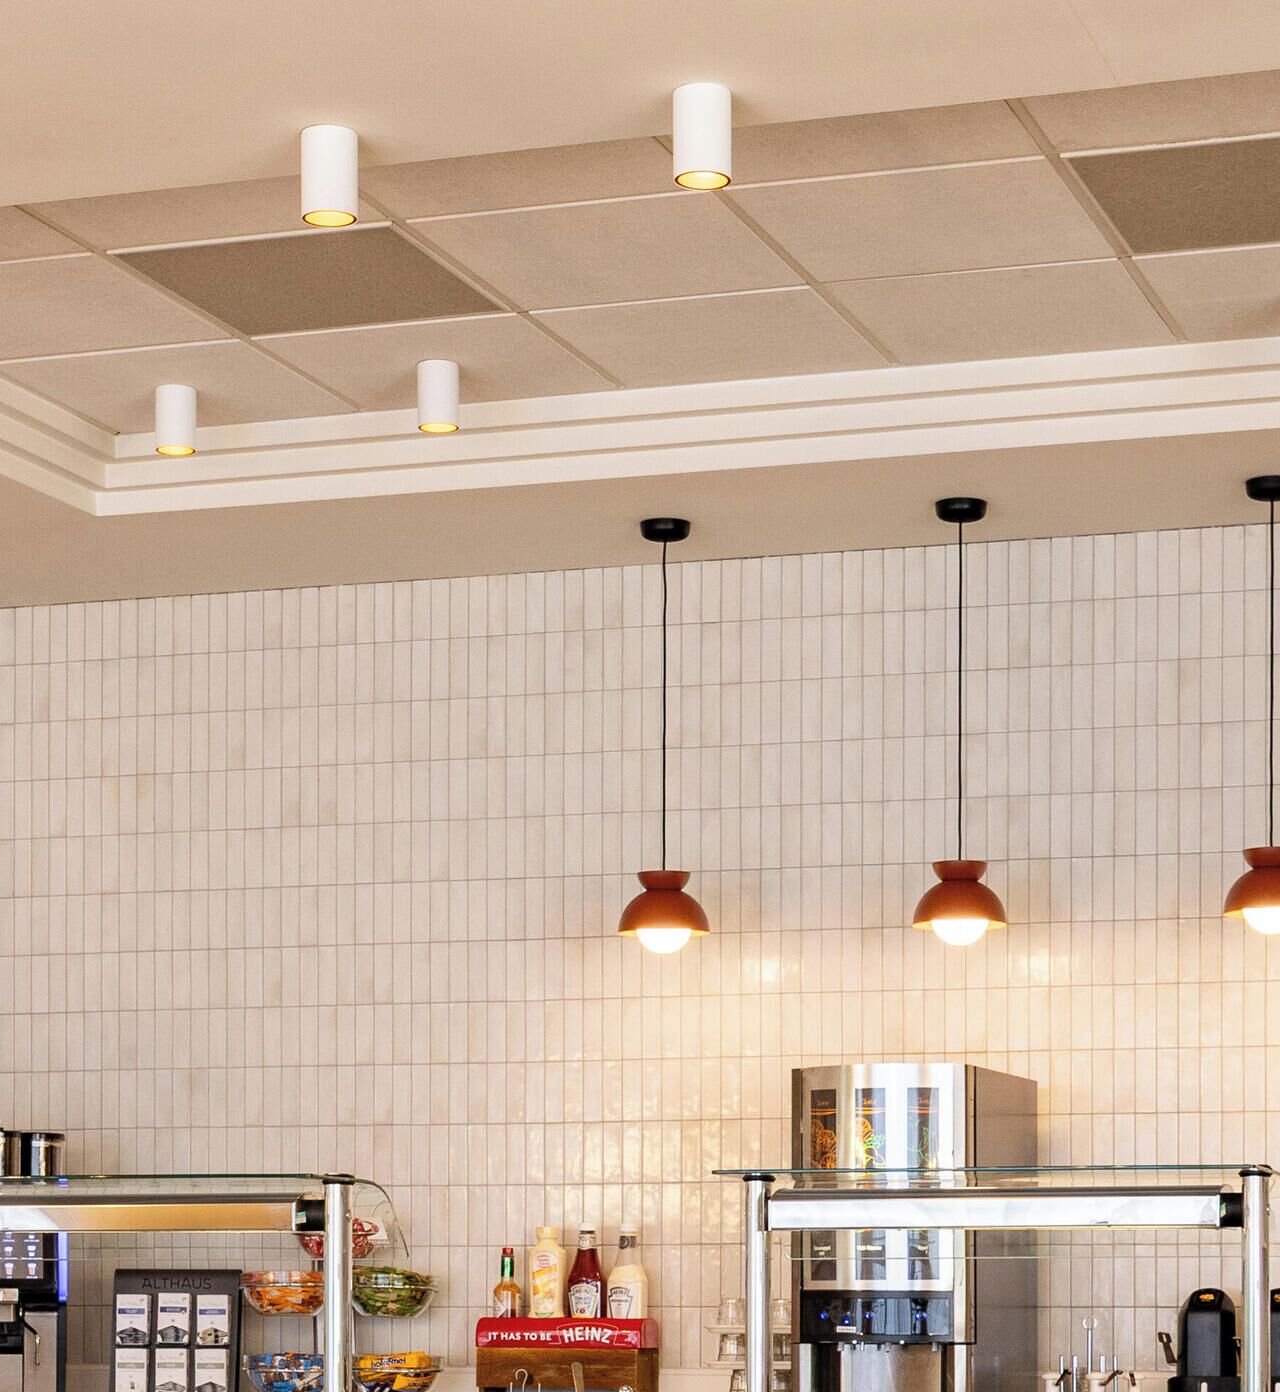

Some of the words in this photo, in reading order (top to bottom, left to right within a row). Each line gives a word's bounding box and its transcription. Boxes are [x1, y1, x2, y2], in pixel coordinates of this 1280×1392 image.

[141, 1277, 212, 1290] ALTHAUS
[488, 1331, 499, 1341] IT
[500, 1331, 521, 1341] HAS
[523, 1331, 538, 1341] TO
[540, 1331, 552, 1341] BE
[562, 1326, 614, 1344] HEINZ
